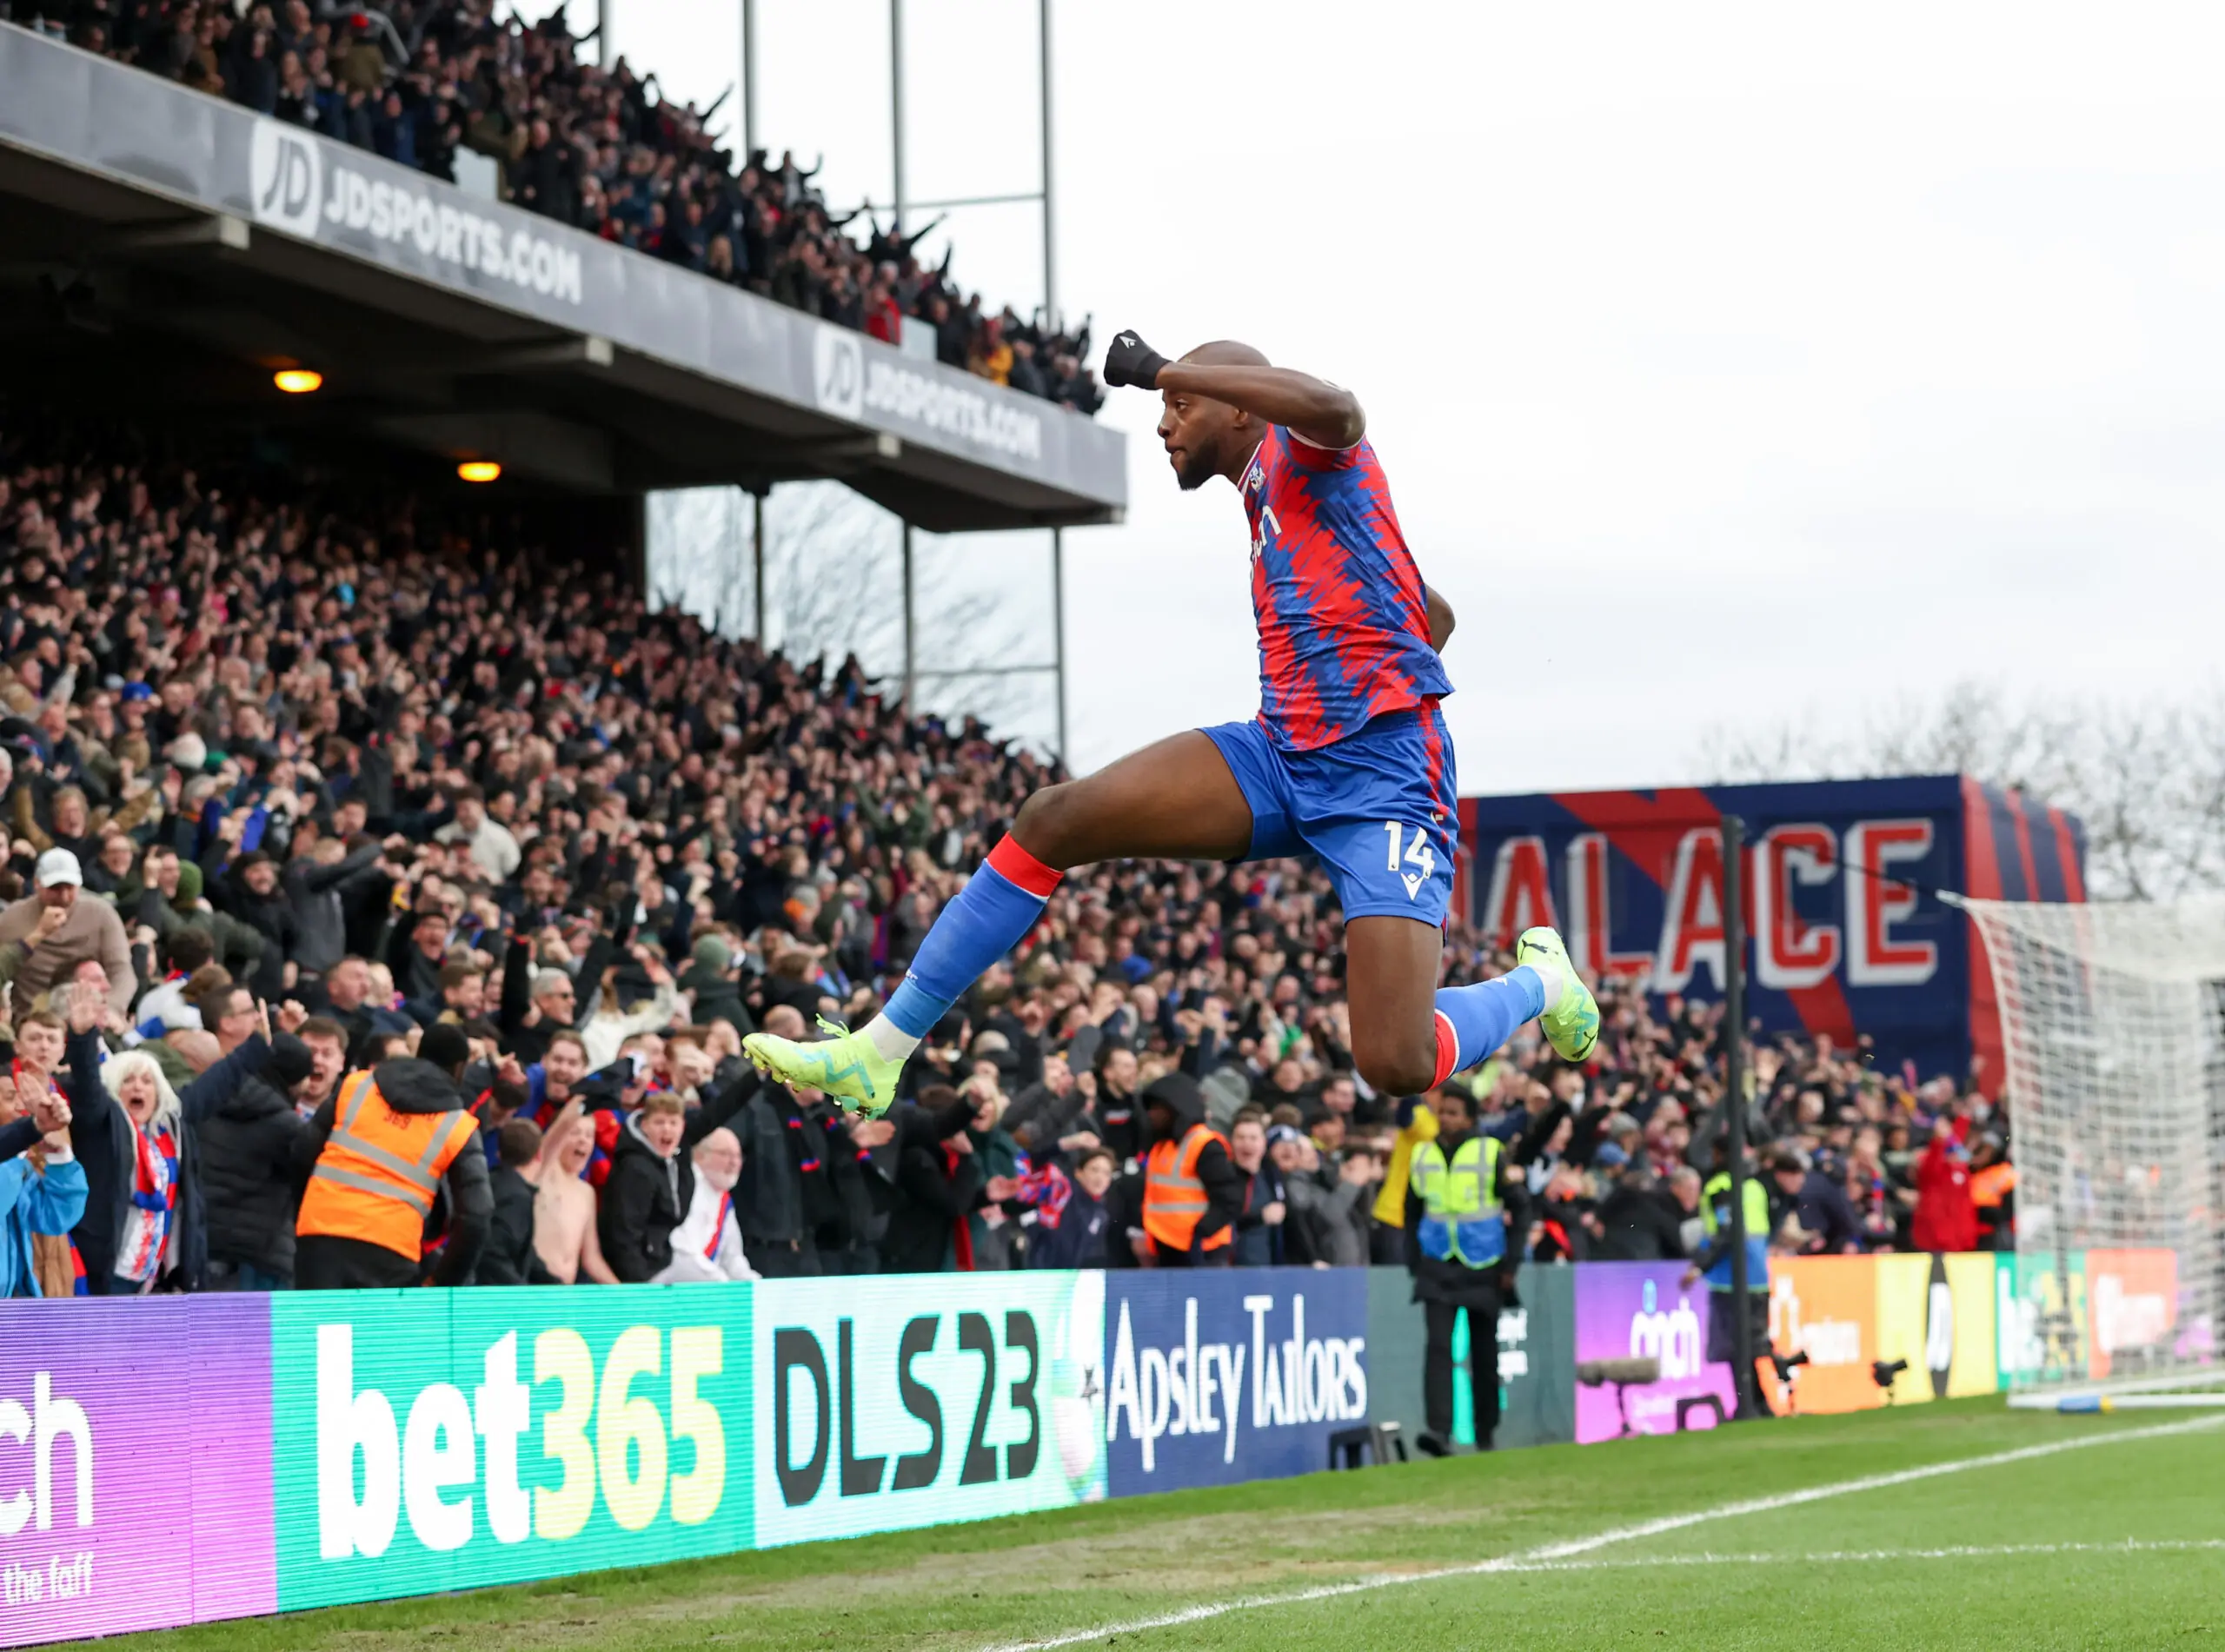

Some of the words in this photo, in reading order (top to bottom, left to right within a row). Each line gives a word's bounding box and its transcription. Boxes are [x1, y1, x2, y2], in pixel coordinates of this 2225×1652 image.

[324, 167, 582, 304] JDSPORTS.COM
[1384, 820, 1435, 879] 14
[1451, 819, 1938, 992] ALACE
[316, 1324, 727, 1560] bet365
[1106, 1297, 1245, 1472] Apsley
[1243, 1293, 1367, 1428] Tailors
[3, 1562, 42, 1603] the
[50, 1551, 94, 1599] faff
